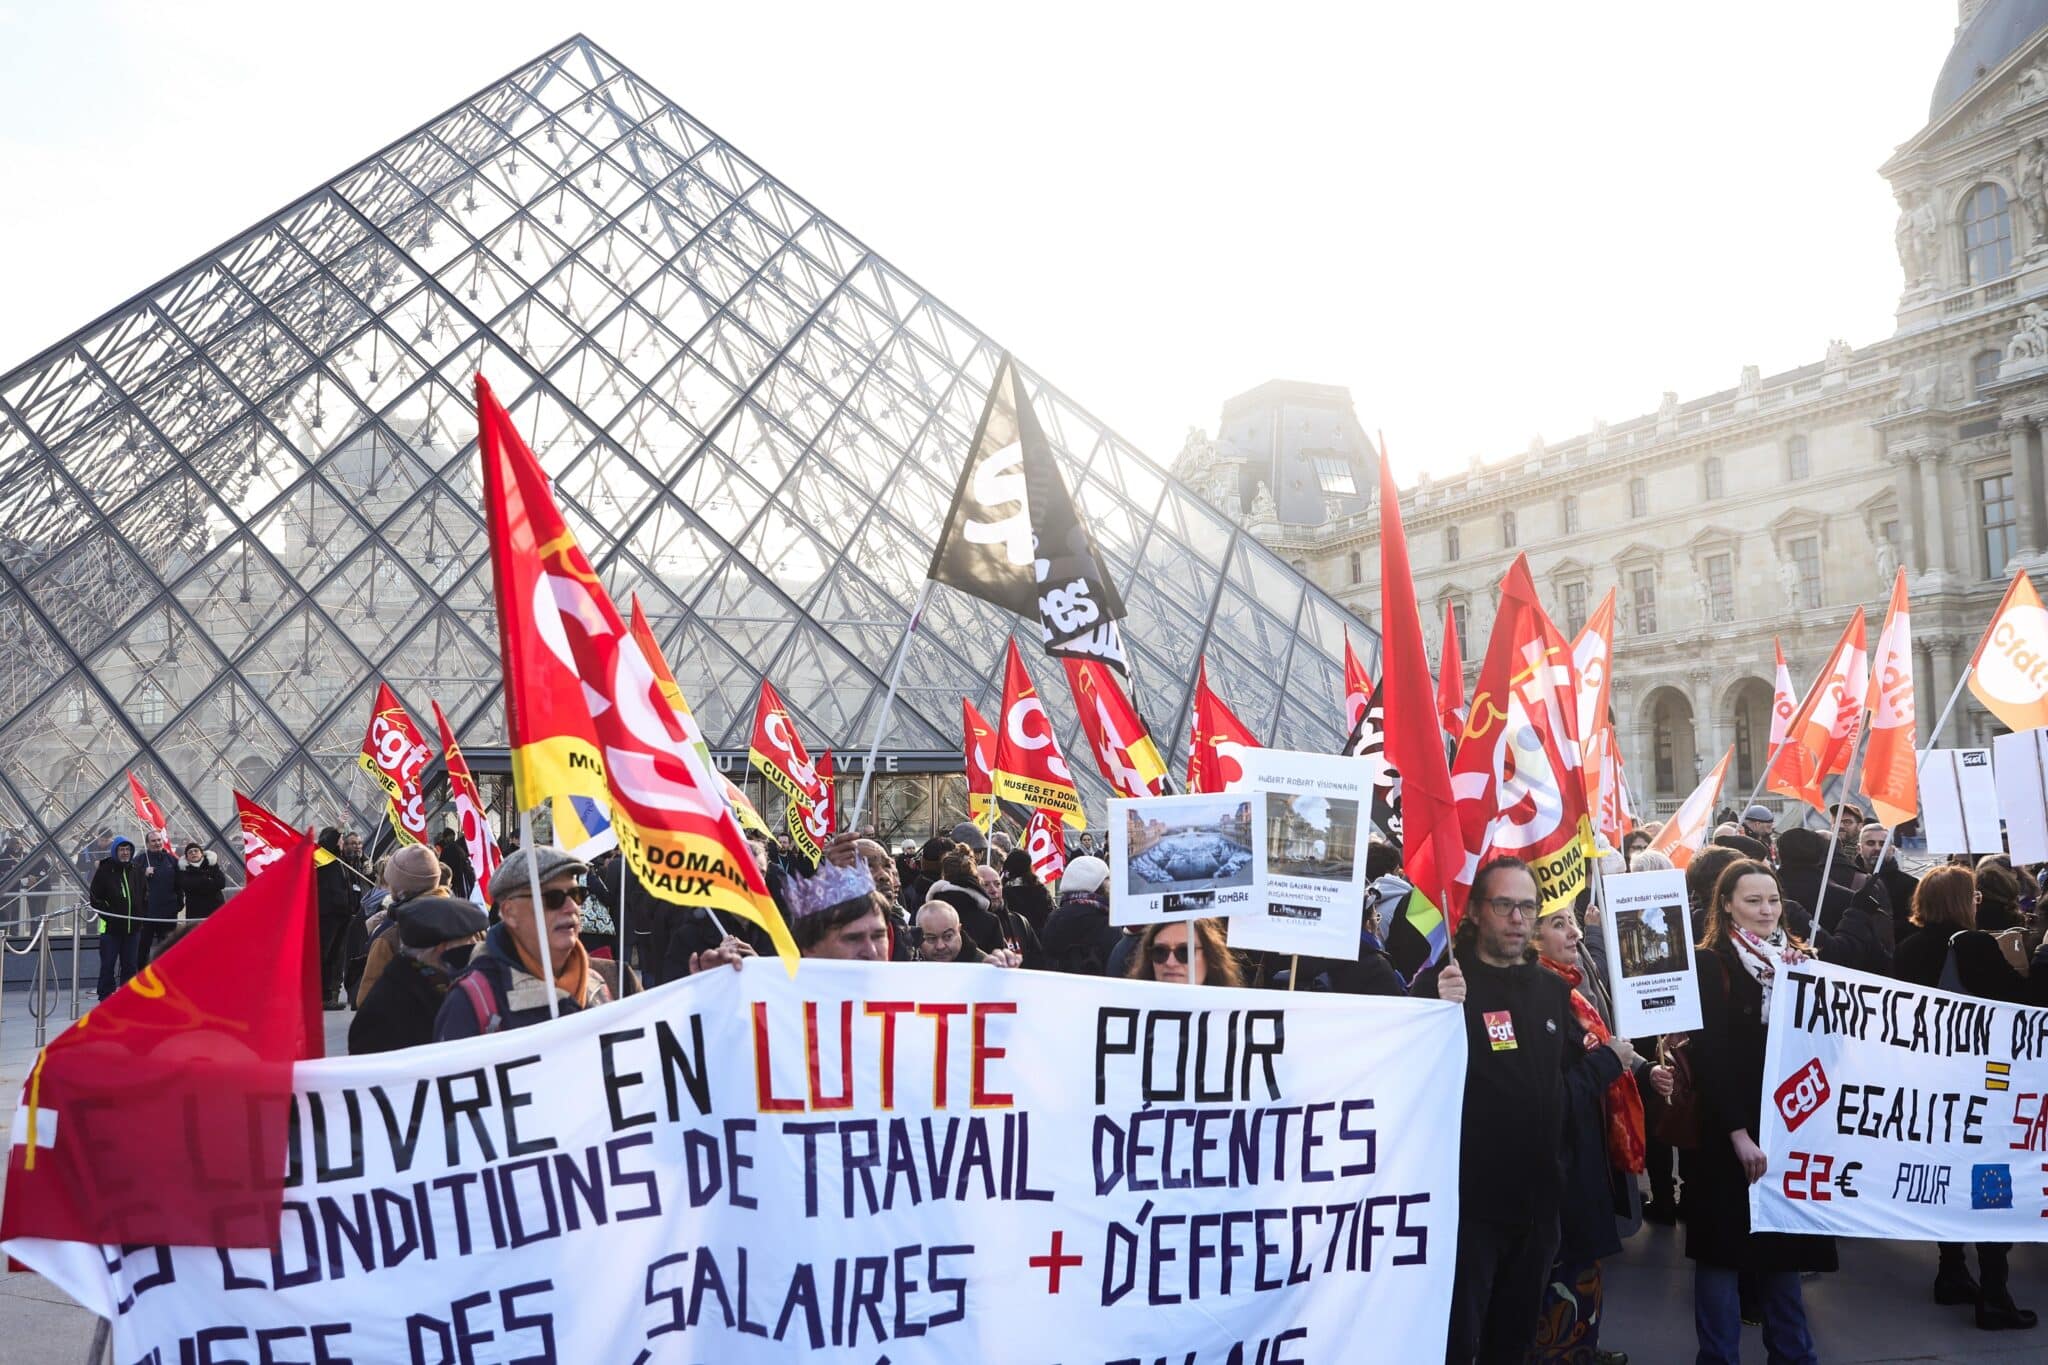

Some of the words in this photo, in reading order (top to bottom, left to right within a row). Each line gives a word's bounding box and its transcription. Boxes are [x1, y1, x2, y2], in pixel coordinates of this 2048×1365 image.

[372, 717, 428, 780] cgt
[1024, 793, 1078, 813] NATIONAUX
[1043, 788, 1056, 798] ET
[1057, 791, 1079, 804] DOMA
[789, 807, 821, 859] CULTURE
[646, 844, 750, 893] DOMAIN
[1537, 843, 1583, 882] DOMAI
[1150, 900, 1159, 910] LE
[1217, 891, 1249, 904] SOMBRE
[1488, 1021, 1514, 1041] cgt
[1787, 971, 1997, 1057] TARIFICATION
[599, 1013, 712, 1133] EN
[751, 1000, 1018, 1114] LUTTE
[1096, 1006, 1285, 1106] POUR
[1781, 1064, 1826, 1120] cgt
[1836, 1084, 1988, 1144] EGALITE
[210, 1131, 662, 1290] CONDITIONS
[684, 1118, 758, 1210] DE
[782, 1110, 1055, 1219] TRAVAIL
[1092, 1099, 1377, 1196] DÉCENTES
[1892, 1162, 1951, 1205] POUR
[644, 1244, 975, 1350] SALAIRES
[1101, 1190, 1431, 1308] D'EFFECTIFS
